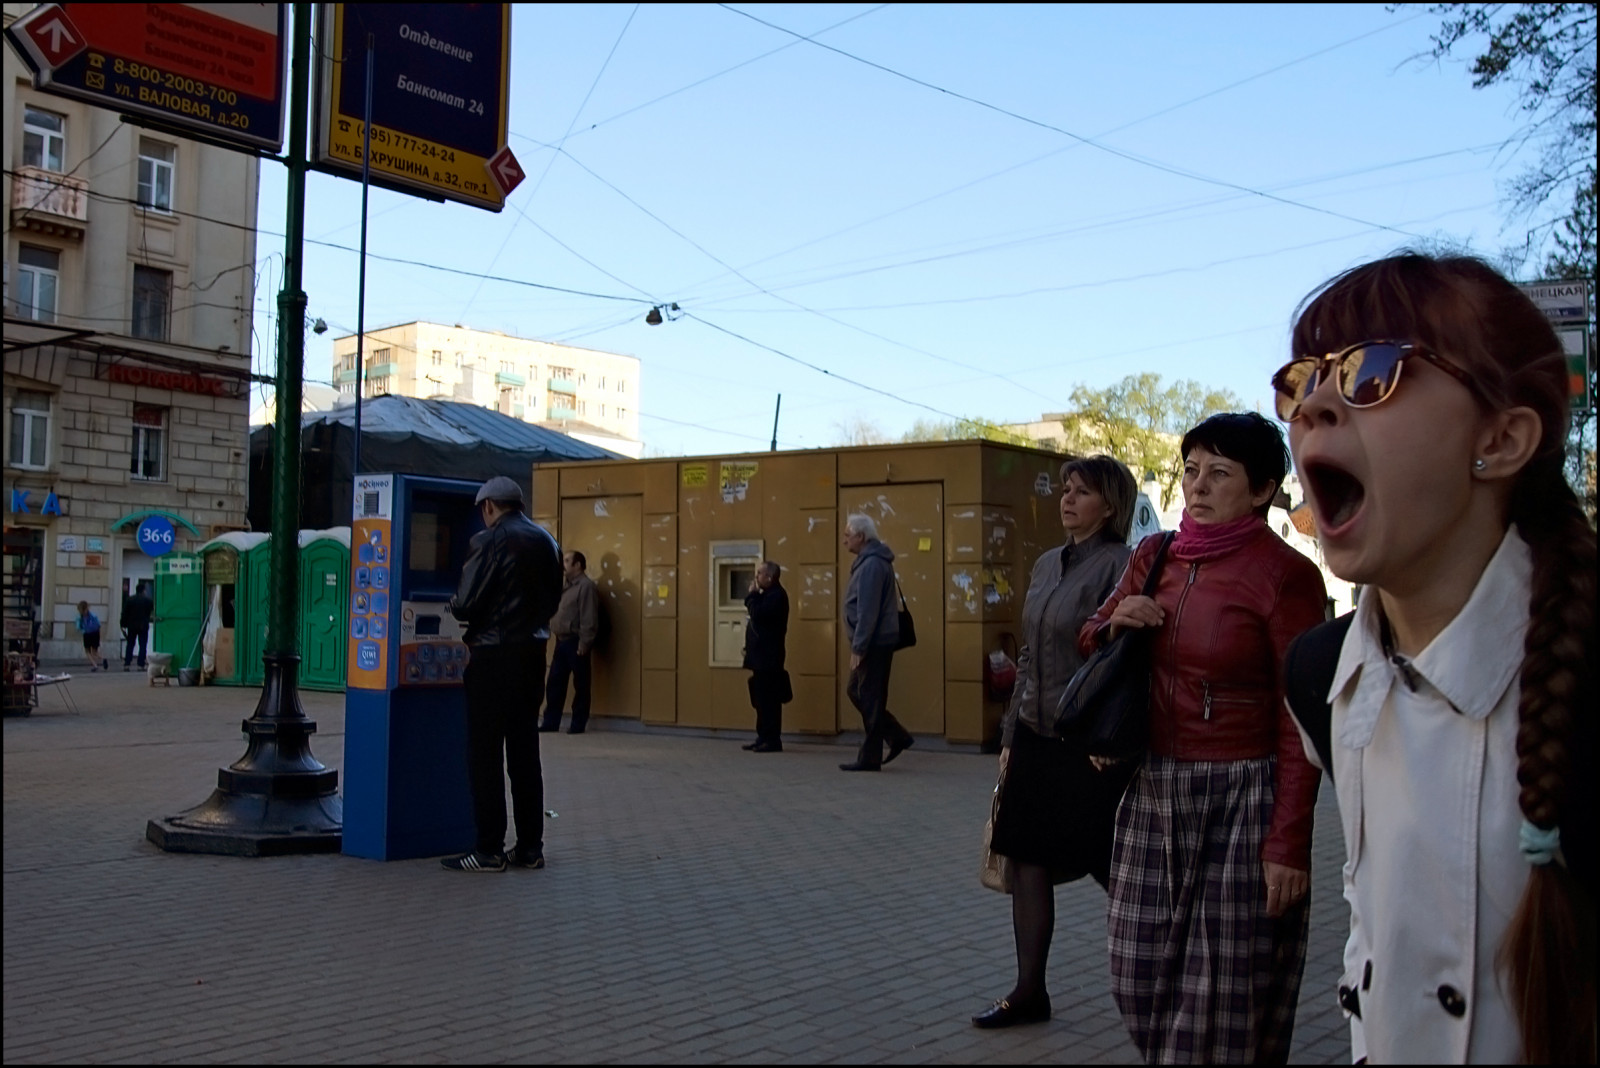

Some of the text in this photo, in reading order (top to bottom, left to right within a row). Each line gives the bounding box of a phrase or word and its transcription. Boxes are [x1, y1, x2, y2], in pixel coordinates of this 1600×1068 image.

[399, 24, 474, 63] Отделение
[113, 58, 238, 107] 8-800-2003-700
[209, 62, 226, 77] 24
[114, 82, 250, 129] ул. ВАЛОВАЯ, д.20
[396, 74, 485, 117] Банкомат 24
[334, 142, 351, 157] ул.
[353, 145, 430, 179] БХРУШИНА
[394, 134, 456, 164] 777-24-24
[112, 365, 226, 397] НОТАРИУС
